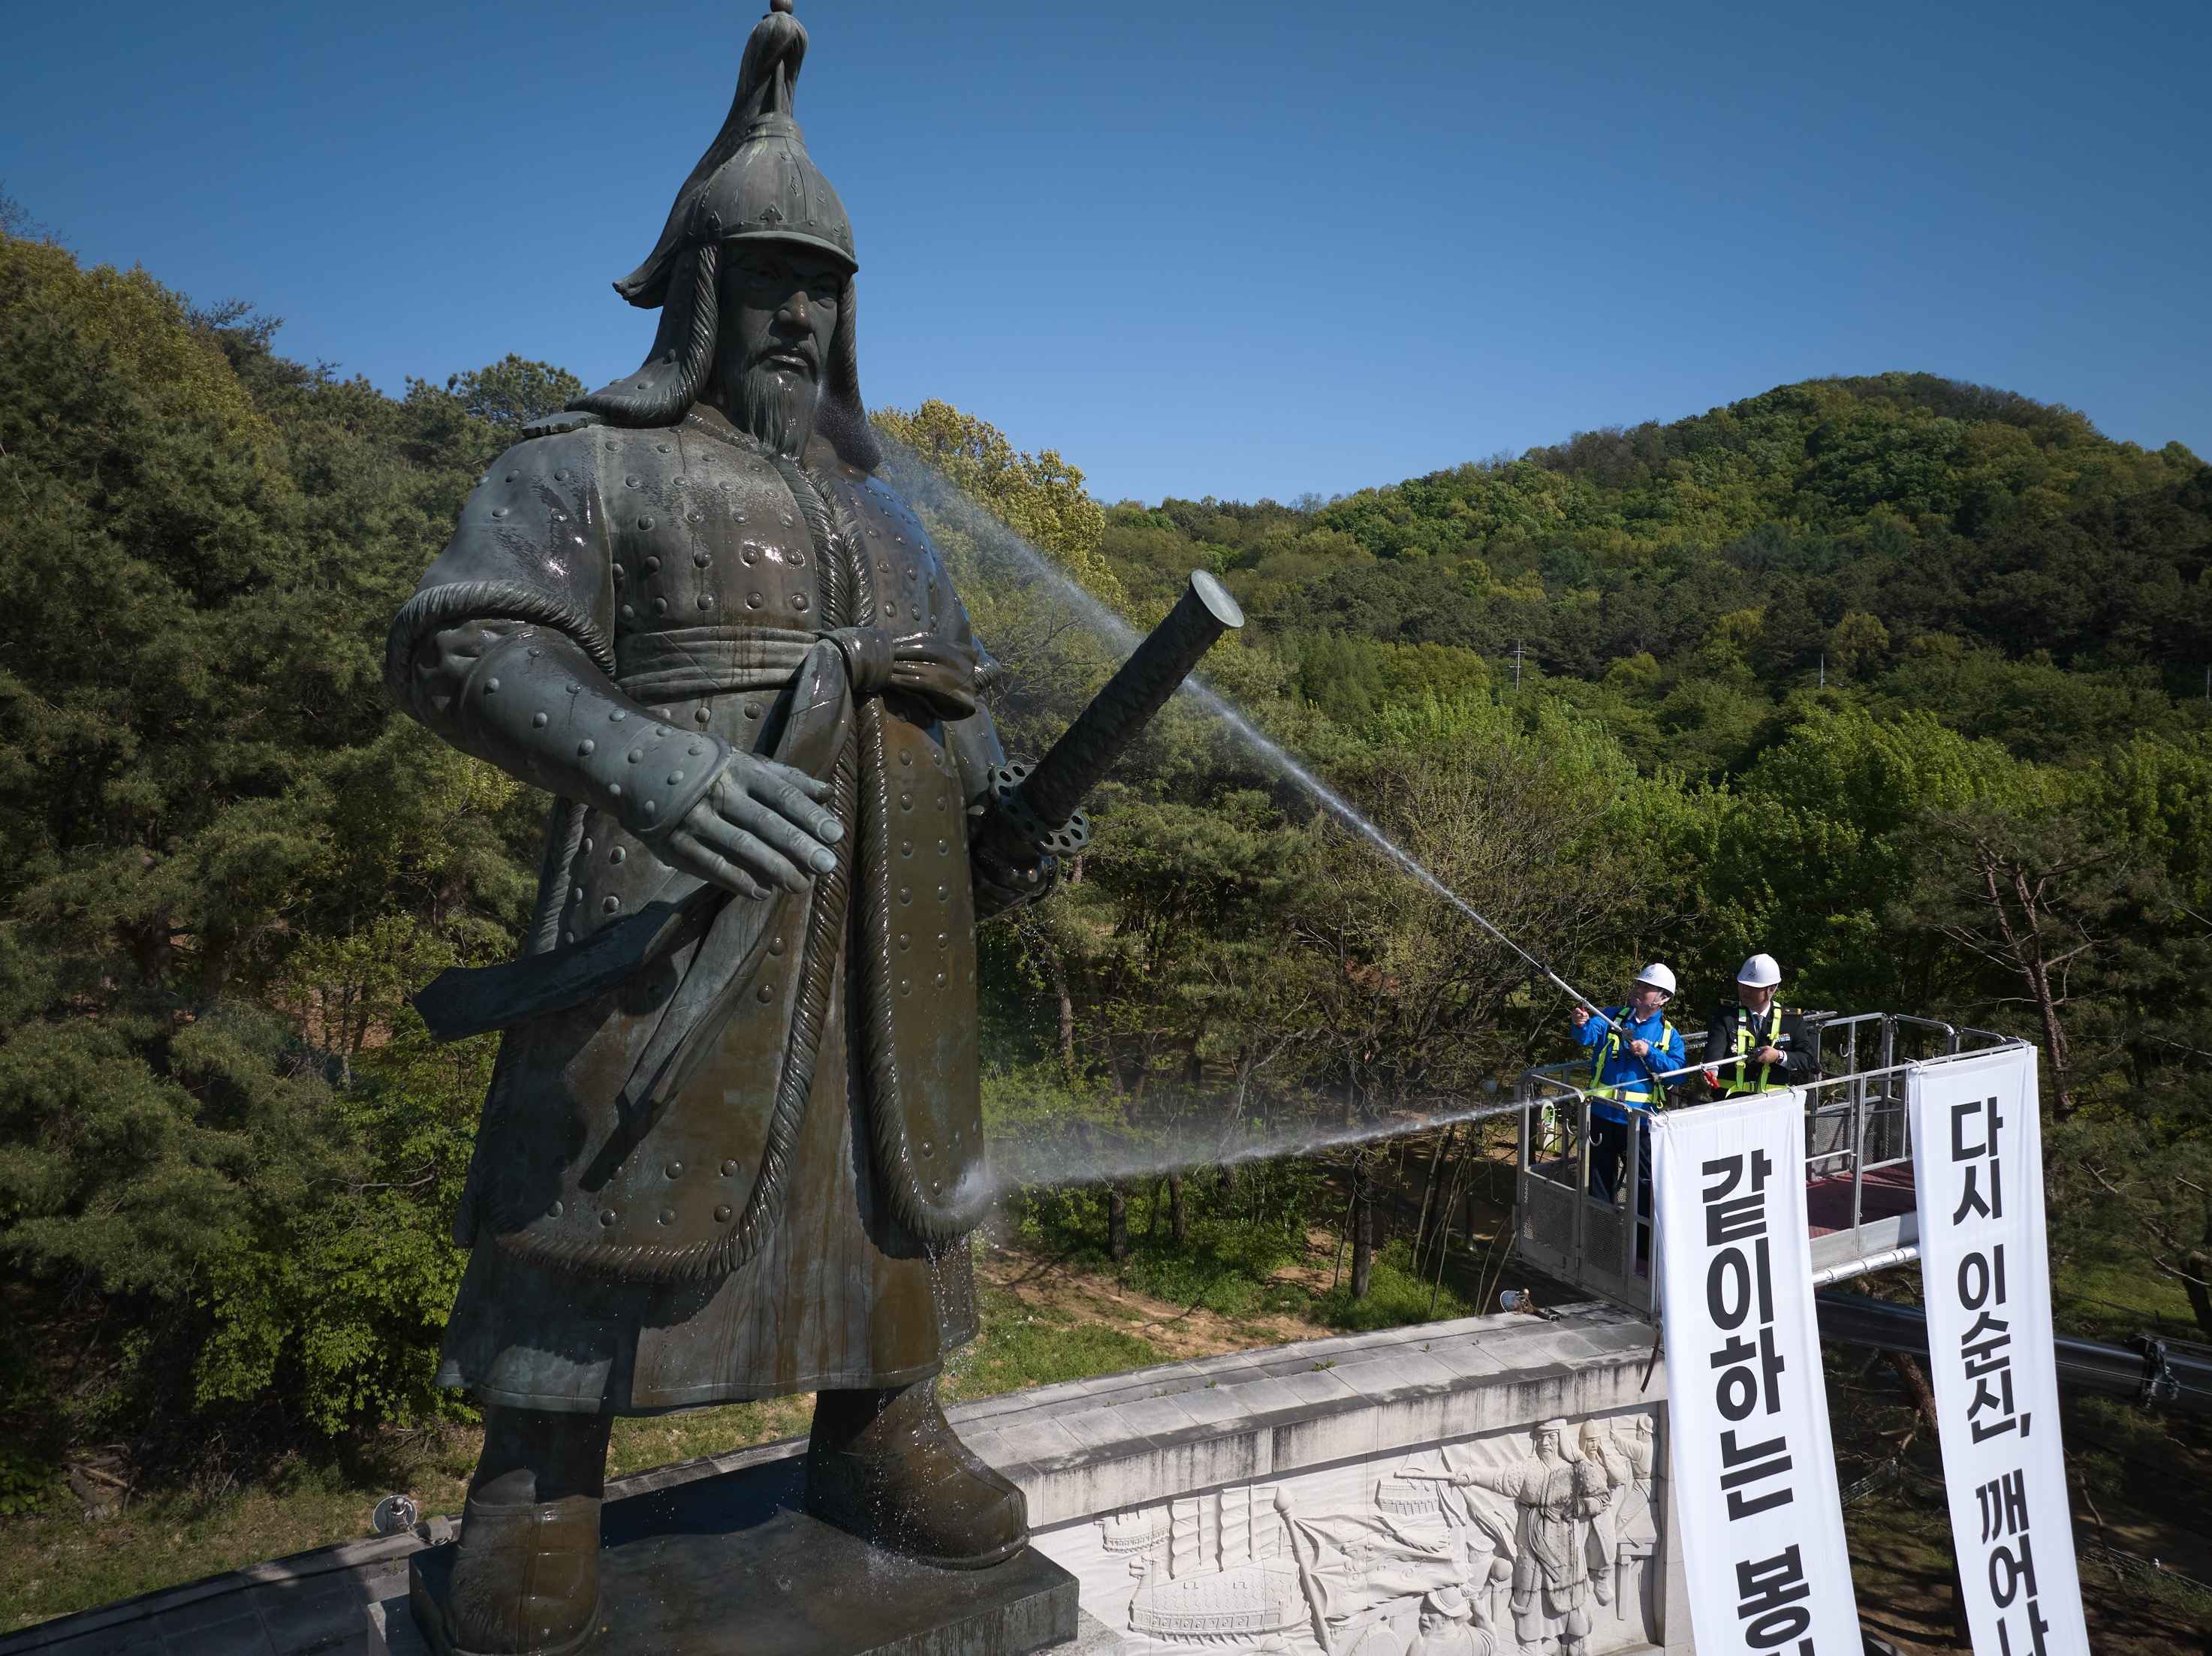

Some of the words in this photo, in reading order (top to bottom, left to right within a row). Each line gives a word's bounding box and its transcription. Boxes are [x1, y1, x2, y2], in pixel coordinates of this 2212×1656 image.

[1951, 1096, 2003, 1226] 다시
[1702, 1149, 1794, 1522] 같이하는
[1957, 1243, 2032, 1444] 이순신,
[1735, 1543, 1816, 1656] 봉
